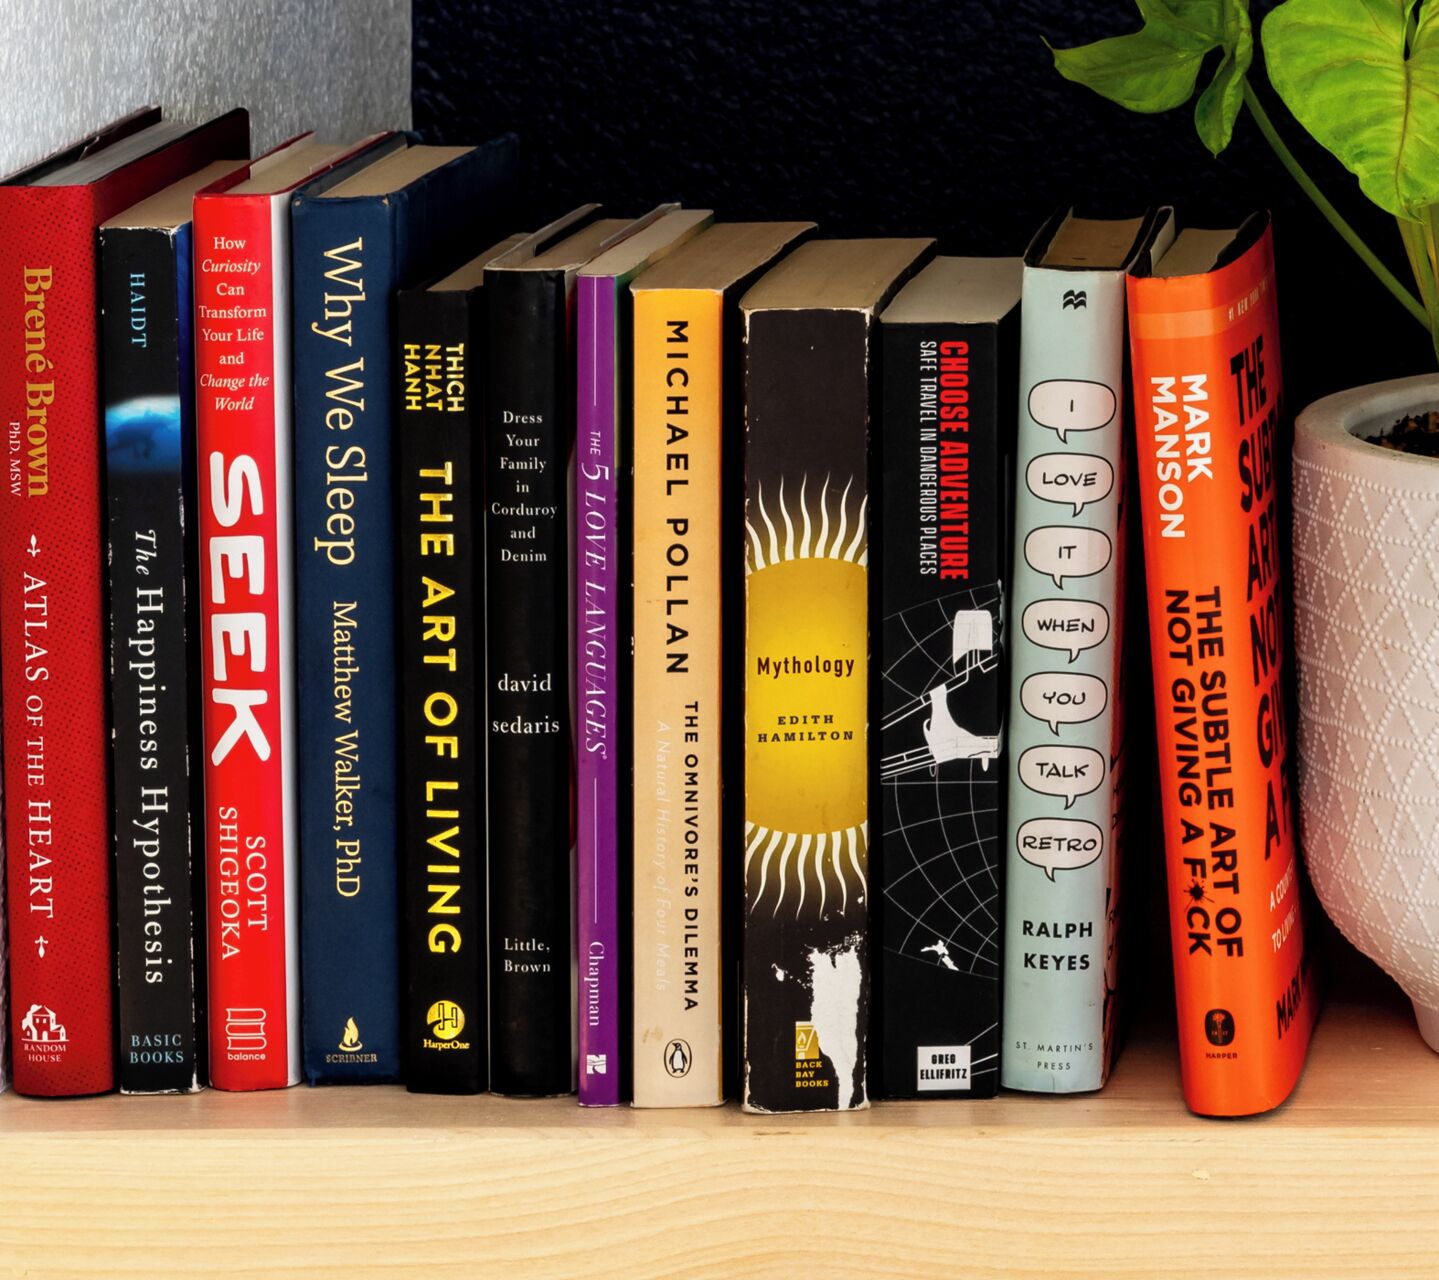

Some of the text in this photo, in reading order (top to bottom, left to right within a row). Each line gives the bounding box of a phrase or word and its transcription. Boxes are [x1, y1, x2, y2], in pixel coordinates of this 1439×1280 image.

[129, 273, 146, 348] HAIDT
[22, 265, 55, 497] Brené Brown
[311, 237, 368, 566] Why We Sleep
[404, 344, 421, 410] HANH
[426, 345, 443, 411] NHAT
[446, 343, 464, 412] THICH
[940, 341, 969, 579] CHOOSE ADVENTURE
[665, 321, 690, 673] MICHAEL POLLAN
[209, 451, 271, 767] SEEK
[498, 674, 552, 692] david
[757, 656, 854, 678] Mythology
[419, 462, 462, 953] THE ART OF LIVING
[492, 717, 560, 734] sedaris
[684, 701, 698, 743] THE
[778, 715, 835, 725] EDITH
[24, 572, 54, 918] ATLAS OF THE HEART
[128, 529, 173, 984] The Happiness Hypothesis
[332, 601, 362, 897] Matthew Walker, PhD
[758, 731, 854, 743] HAMILTON
[1023, 837, 1097, 852] RETRO
[219, 807, 241, 960] SHIGEOKA
[246, 836, 268, 931] SCOTT
[1023, 921, 1092, 937] RALPH
[684, 908, 698, 1011] DILEMMA
[1024, 955, 1089, 970] KEYES
[130, 1050, 184, 1064] BOOKS
[131, 1034, 181, 1047] BASIC
[228, 1052, 266, 1060] balance
[326, 1054, 378, 1063] SCRIBNER
[423, 1039, 470, 1050] HarperOne
[931, 1054, 956, 1065] GREG
[920, 1069, 967, 1080] ELLIFRITZ
